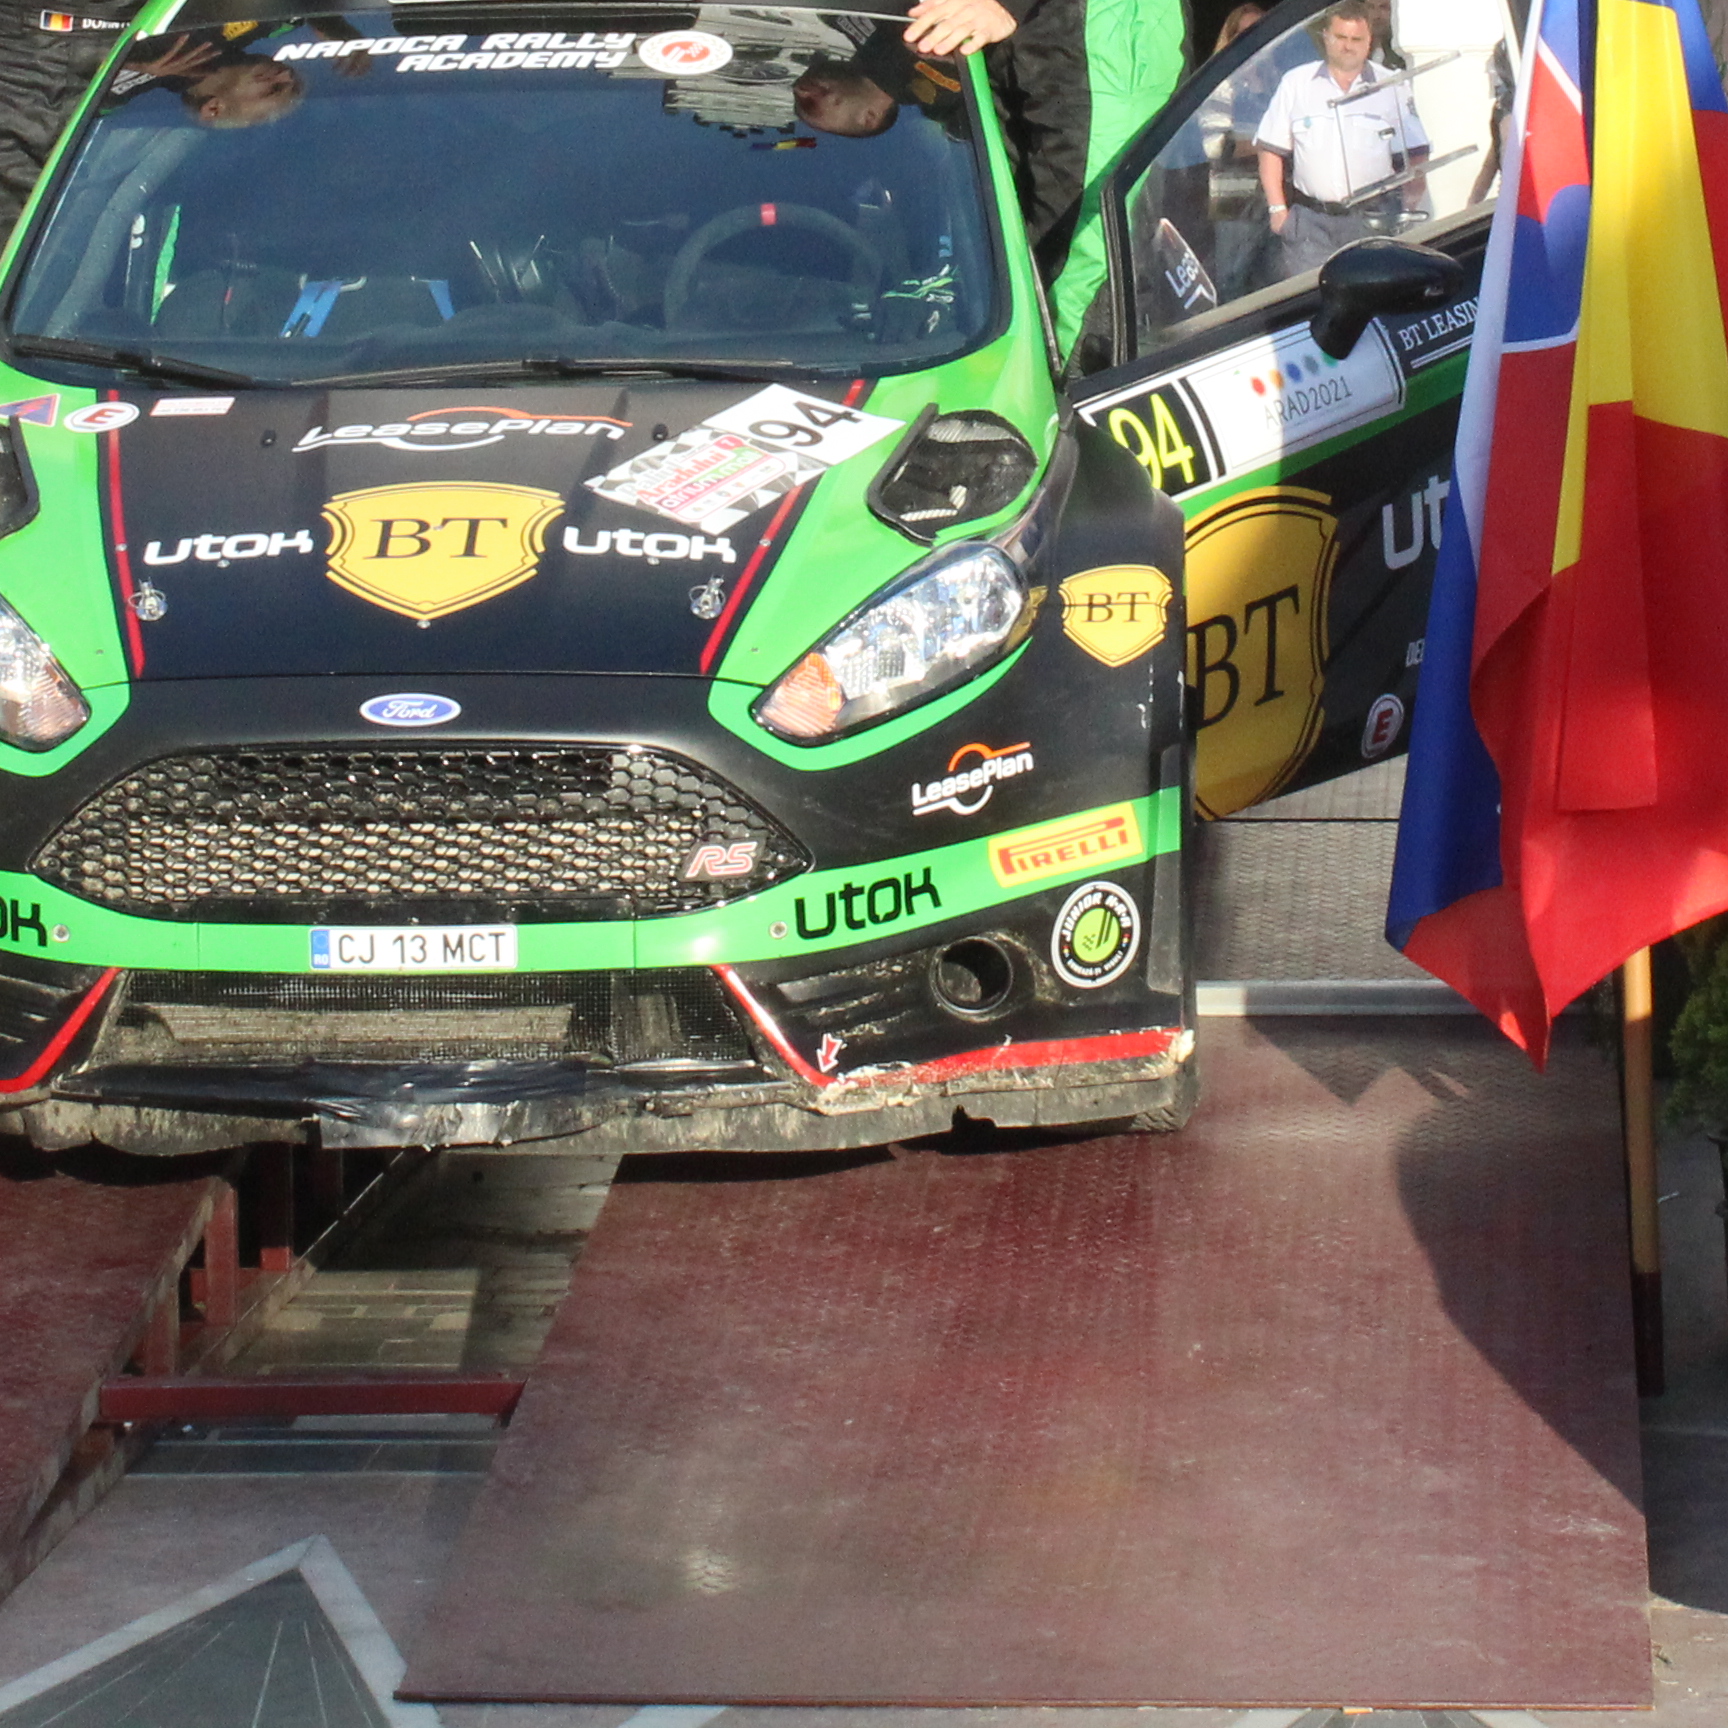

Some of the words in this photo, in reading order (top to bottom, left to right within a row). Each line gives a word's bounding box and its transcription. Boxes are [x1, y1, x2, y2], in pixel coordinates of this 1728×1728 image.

[273, 34, 468, 63] NAPOCA
[480, 30, 637, 51] RALLY
[396, 50, 632, 72] ACADEMY
[1398, 325, 1421, 352] BT
[299, 418, 626, 446] LeasePlan
[748, 399, 863, 447] 94
[363, 517, 509, 560] BT
[1083, 592, 1150, 624] BT
[1186, 584, 1301, 730] BT
[381, 698, 437, 721] Ford
[911, 751, 1034, 807] LeasePlan
[686, 840, 758, 878] RS
[998, 815, 1129, 876] PIRELLI
[337, 933, 376, 964] CJ
[392, 933, 427, 963] 13
[441, 931, 504, 963] MCT
